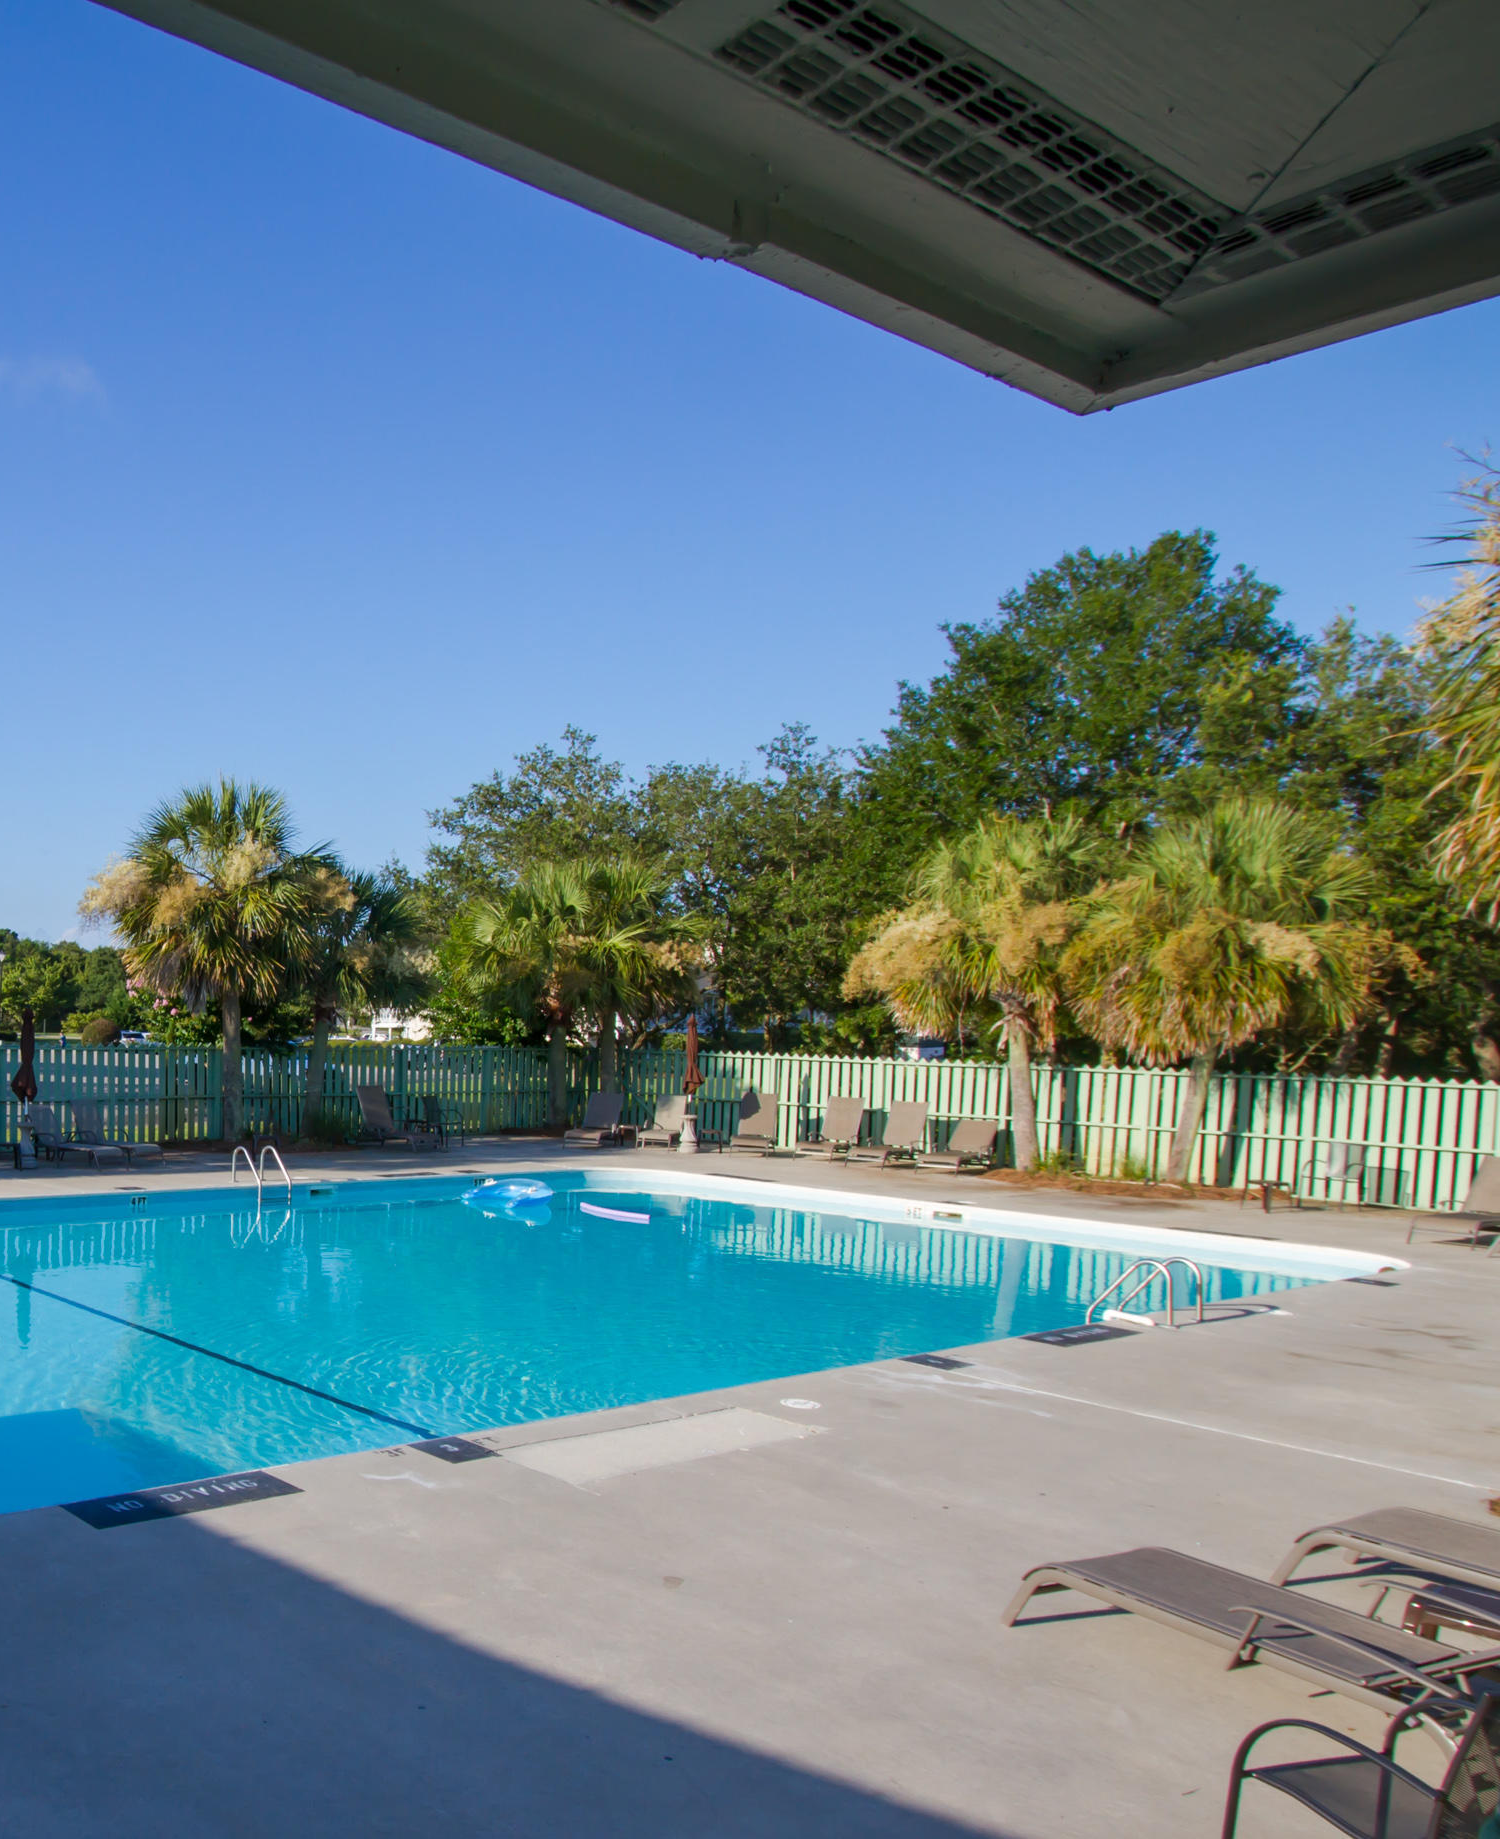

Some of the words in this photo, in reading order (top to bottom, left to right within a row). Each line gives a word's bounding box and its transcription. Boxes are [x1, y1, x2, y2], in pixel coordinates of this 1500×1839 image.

[137, 1196, 146, 1206] FT
[106, 1500, 144, 1512] NO
[160, 1479, 259, 1503] DIVING
